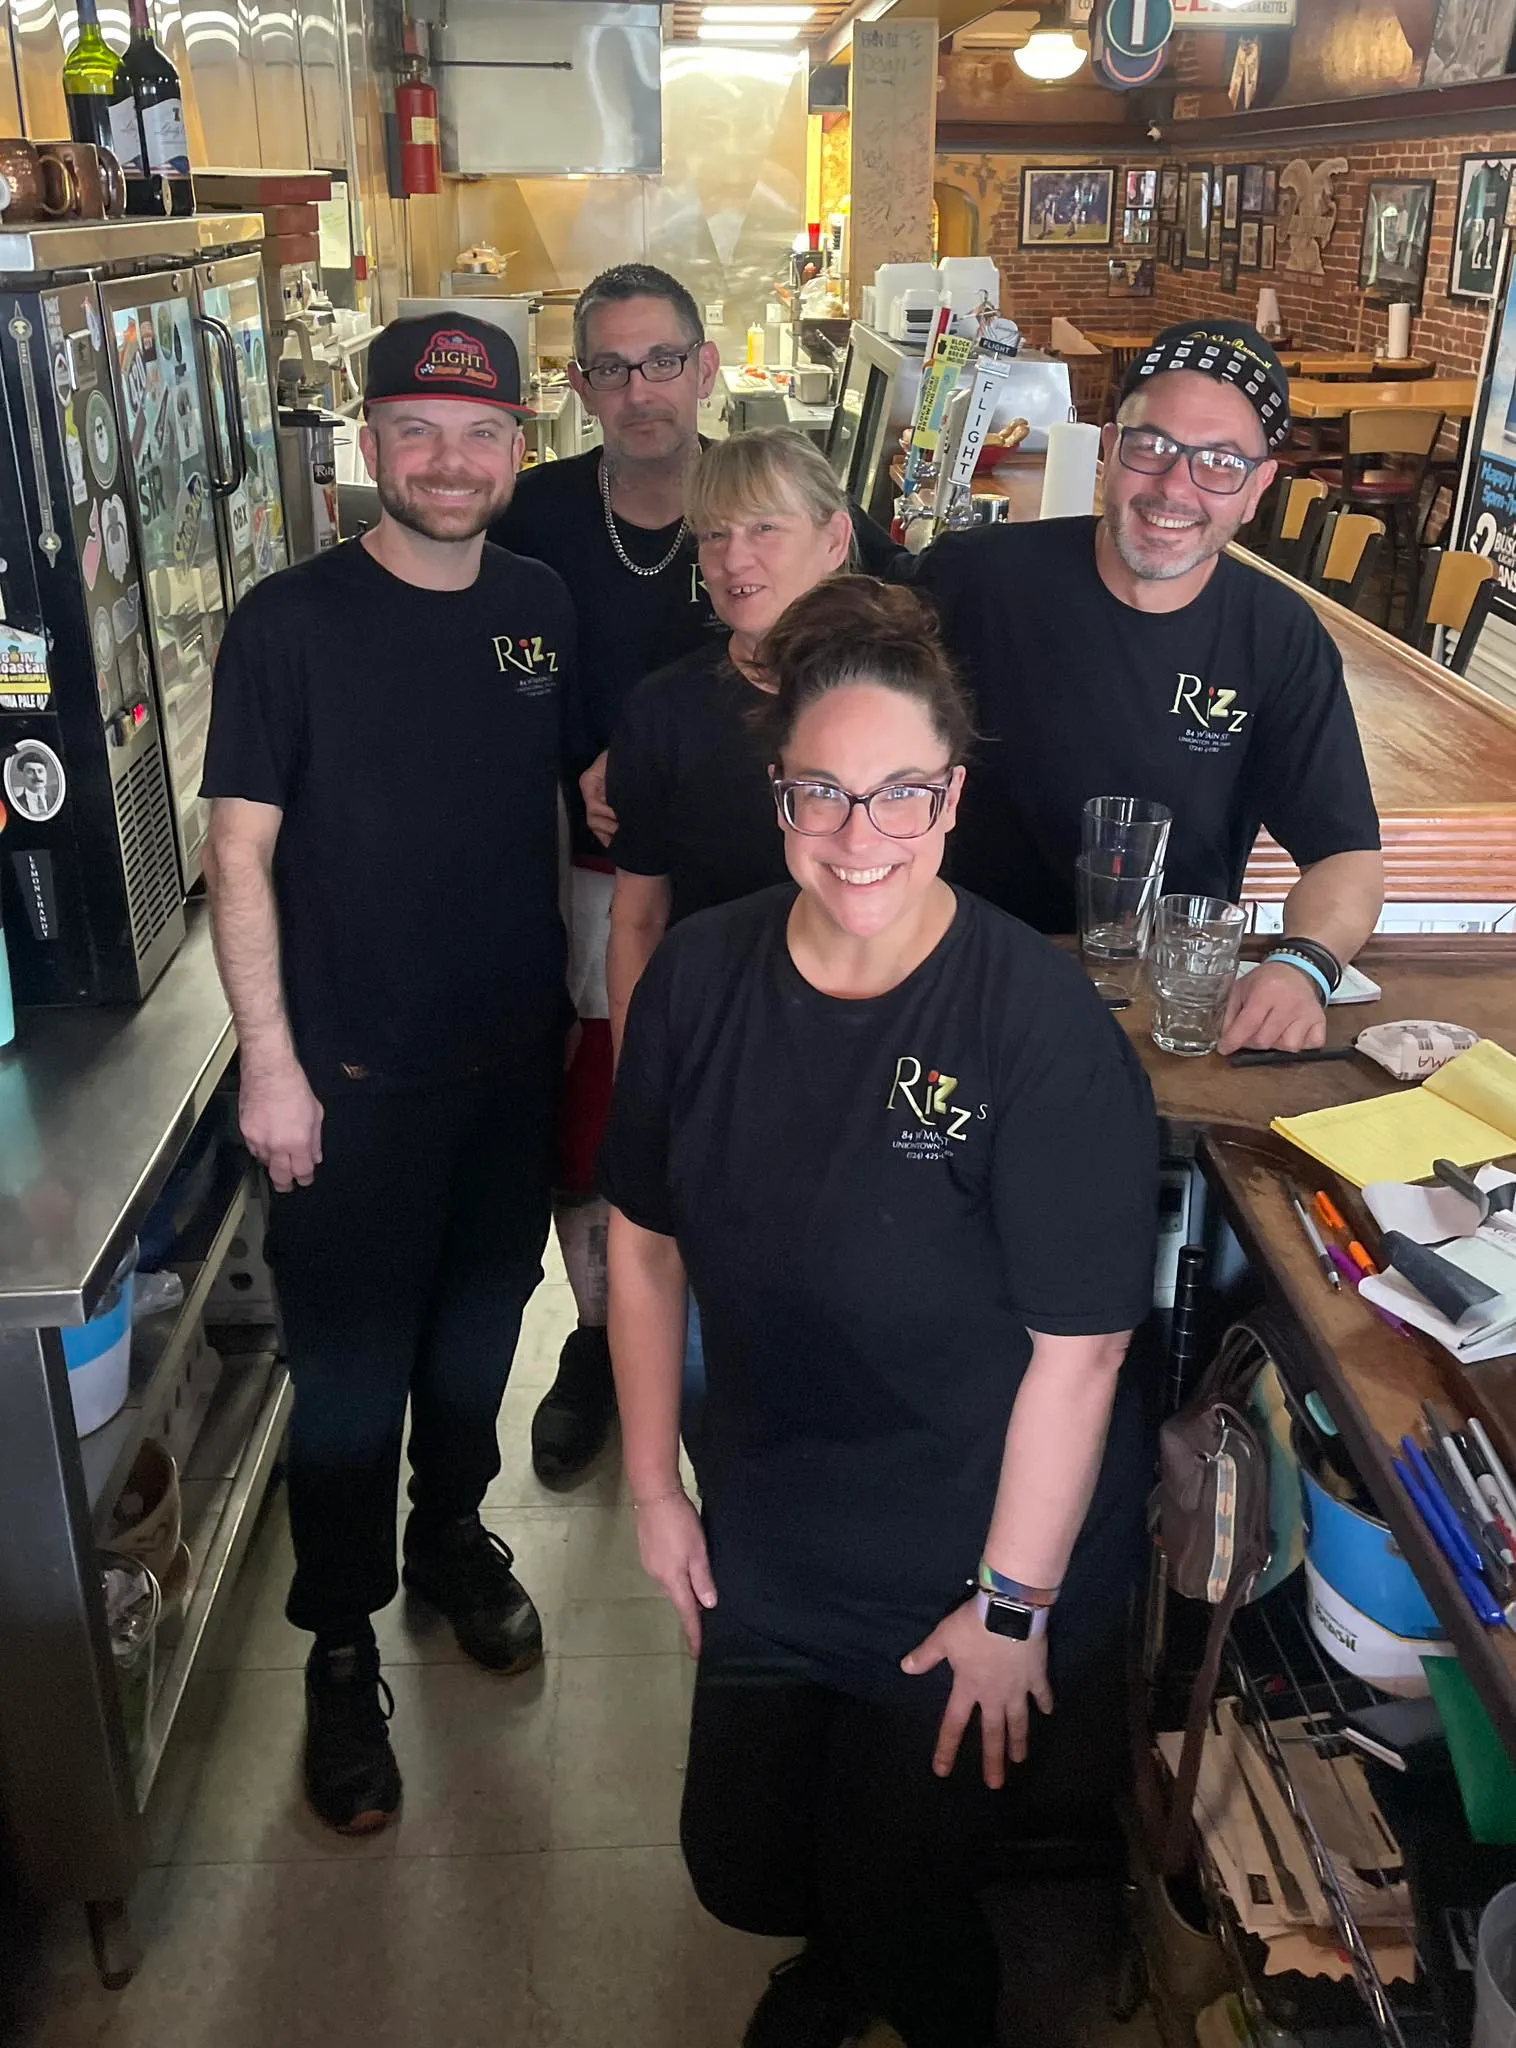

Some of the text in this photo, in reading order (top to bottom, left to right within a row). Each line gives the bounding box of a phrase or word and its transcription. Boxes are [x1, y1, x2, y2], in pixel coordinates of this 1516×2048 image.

[982, 341, 1010, 353] FLIGHT
[431, 351, 483, 368] LIGHT
[959, 380, 993, 476] FLIGHT
[233, 503, 248, 531] OBX
[491, 635, 559, 674] Rizz
[0, 662, 47, 674] oastal
[18, 694, 37, 709] PALE
[1185, 728, 1195, 737] 84
[29, 855, 41, 892] LEMON
[901, 1130, 913, 1141] 84
